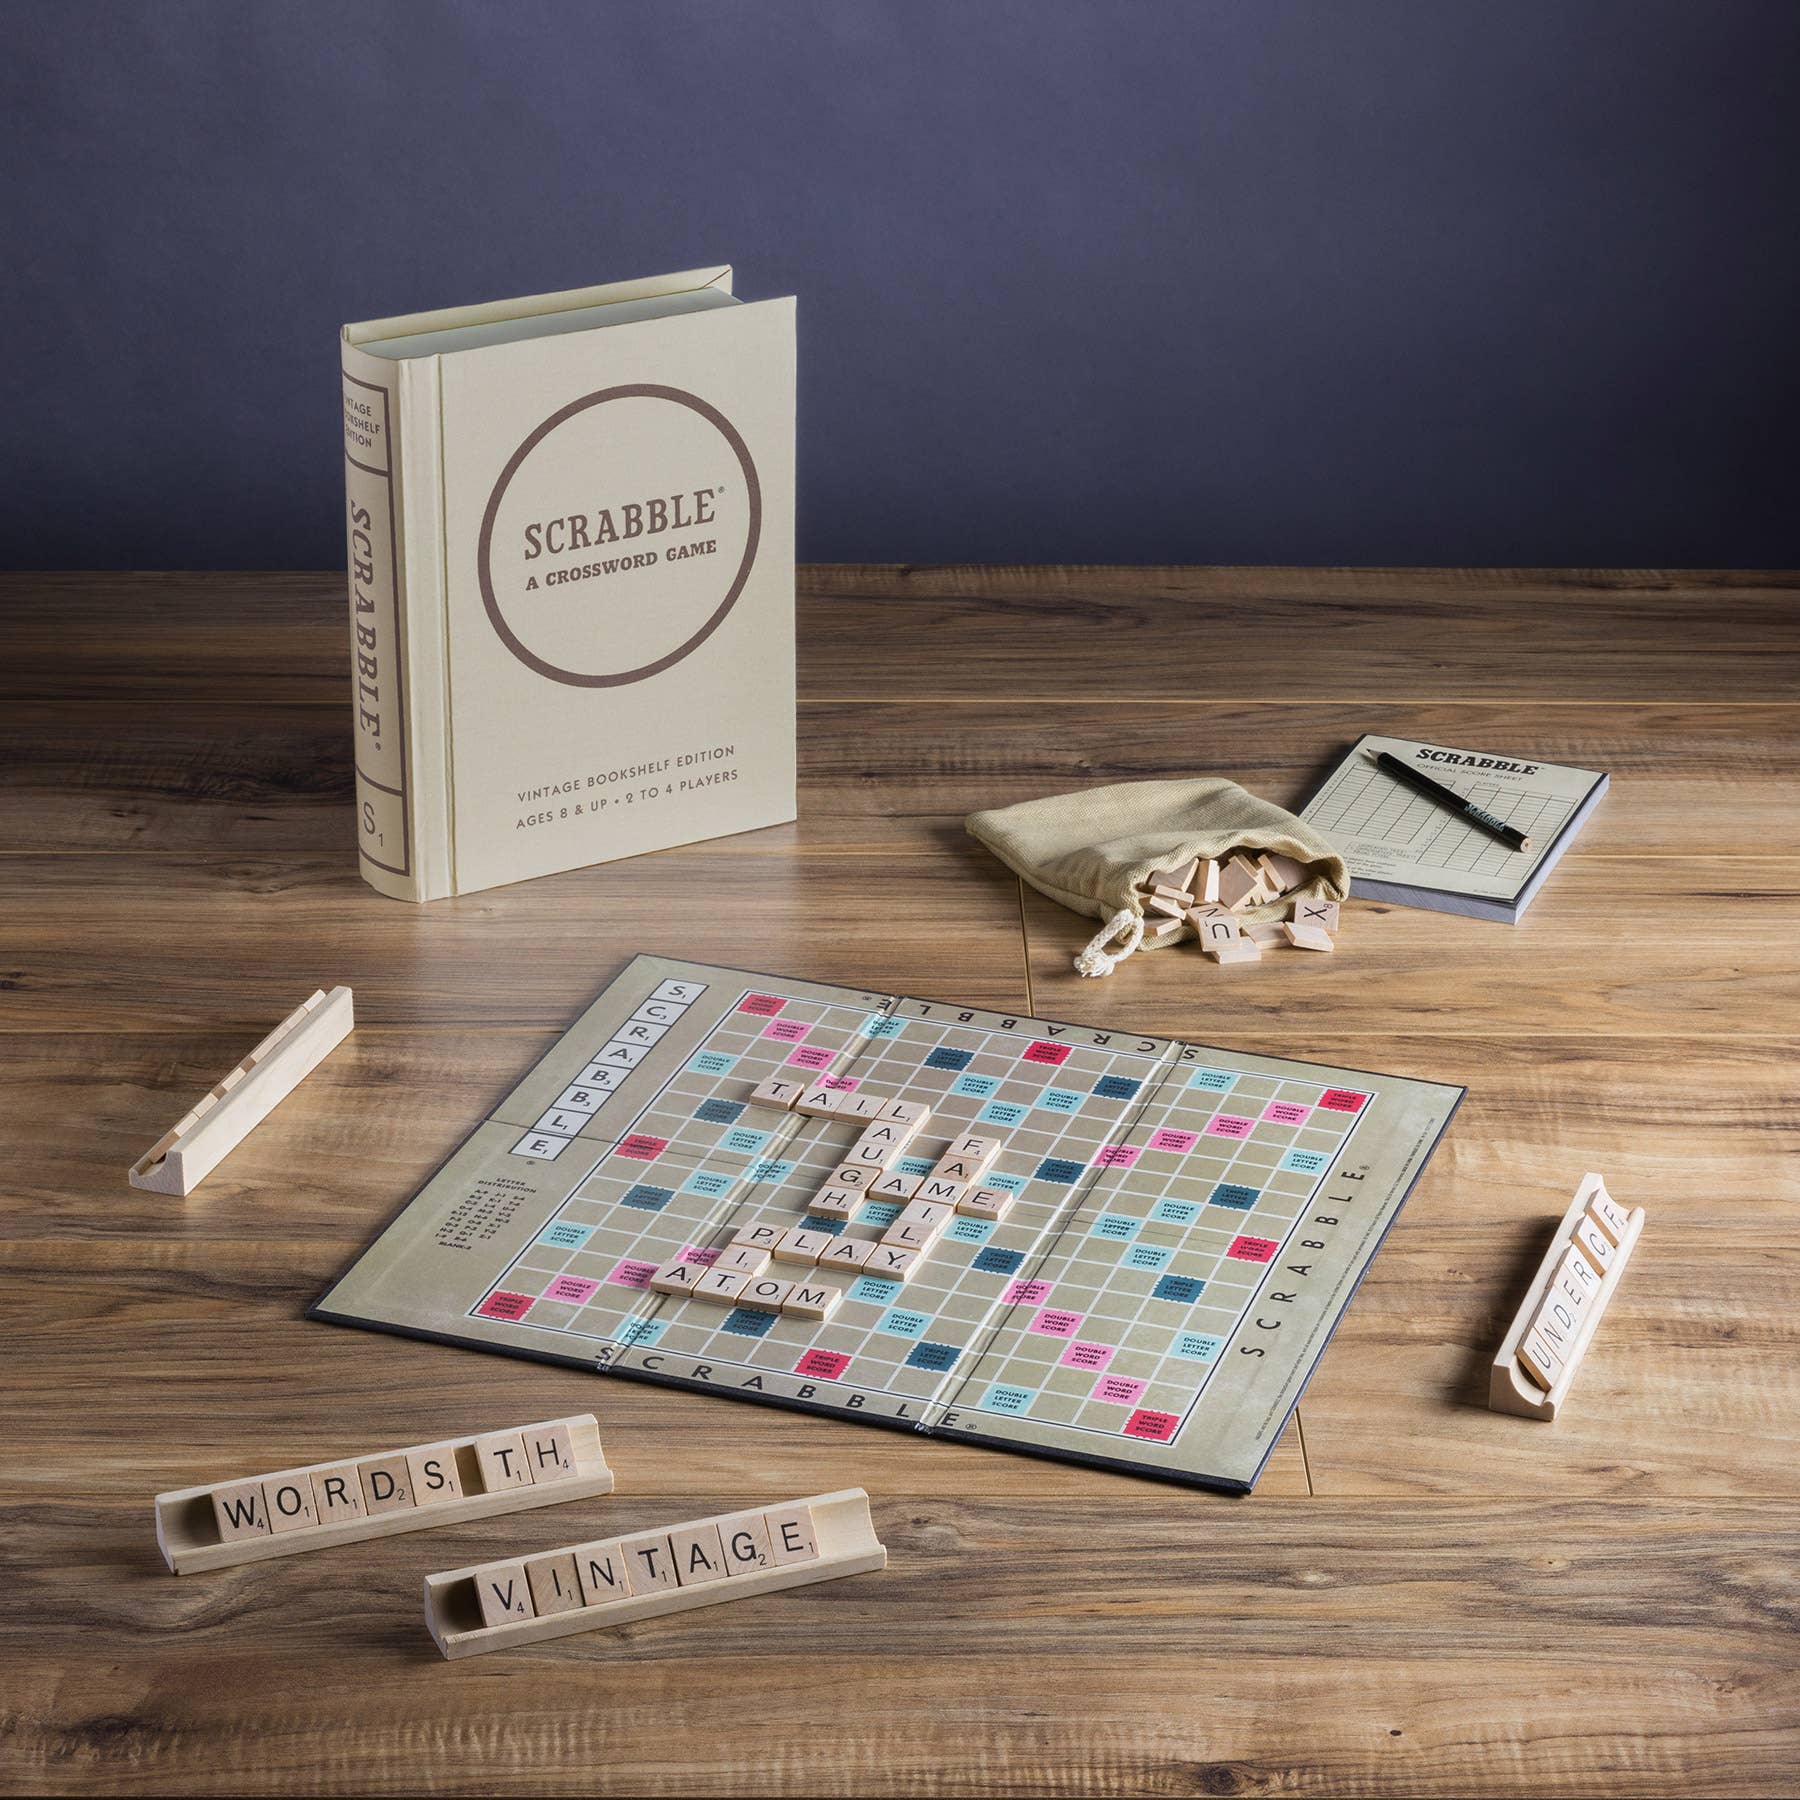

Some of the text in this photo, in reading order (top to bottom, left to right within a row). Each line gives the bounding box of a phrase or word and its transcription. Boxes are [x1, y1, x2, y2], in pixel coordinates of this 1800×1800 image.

[525, 539, 717, 591] A CROSSWORD GAME
[1416, 748, 1540, 776] SCRABBLE
[517, 745, 735, 802] VINTAGE BOOKSHELF EDITION
[516, 769, 738, 829] AGES 8 & UP 2 TO 4 PLAYERS
[775, 1022, 805, 1030] DOUBLE
[1200, 1076, 1226, 1084] LETTER
[1201, 1072, 1231, 1080] DOUBLE
[964, 1077, 994, 1085] DOUBLE
[960, 1086, 986, 1094] SCORE
[1048, 1092, 1079, 1100] DOUBLE
[991, 1105, 1022, 1113] DOUBLE
[1045, 1101, 1070, 1109] SCORE
[1274, 1104, 1305, 1113] DOUBLE
[990, 1109, 1017, 1117] LETTER
[1271, 1113, 1297, 1121] SCORE
[1274, 1109, 1300, 1117] WORD
[987, 1114, 1013, 1122] SCORE
[1218, 1117, 1249, 1126] DOUBLE
[1217, 1122, 1243, 1130] WORD
[732, 1131, 763, 1140] DOUBLE
[1214, 1127, 1241, 1135] SCORE
[731, 1136, 758, 1144] LETTER
[1161, 1132, 1192, 1140] DOUBLE
[727, 1141, 754, 1149] SCORE
[1157, 1141, 1184, 1149] SCORE
[1292, 1152, 1324, 1161] DOUBLE
[1289, 1162, 1316, 1170] SCORE
[1292, 1157, 1319, 1166] LETTER
[695, 1180, 722, 1188] LETTER
[697, 1175, 728, 1184] DOUBLE
[988, 1176, 1020, 1185] DOUBLE
[691, 1184, 718, 1193] SCORE
[987, 1181, 1015, 1189] LETTER
[1163, 1202, 1195, 1211] DOUBLE
[1160, 1212, 1187, 1220] SCORE
[1162, 1207, 1190, 1216] LETTER
[957, 1220, 989, 1229] DOUBLE
[1104, 1217, 1136, 1227] DOUBLE
[554, 1225, 586, 1234] DOUBLE
[956, 1225, 983, 1234] LETTER
[1100, 1227, 1127, 1236] SCORE
[552, 1230, 580, 1239] LETTER
[953, 1230, 980, 1239] SCORE
[548, 1235, 576, 1244] SCORE
[1242, 1239, 1269, 1248] TRIPLE
[1134, 1248, 1167, 1257] DOUBLE
[1236, 1249, 1264, 1258] SCORE
[1133, 1253, 1162, 1262] LETTER
[1131, 1258, 1158, 1267] SCORE
[559, 1279, 592, 1289] DOUBLE
[862, 1280, 895, 1290] DOUBLE
[558, 1285, 585, 1293] WORD
[861, 1286, 889, 1295] LETTER
[553, 1290, 581, 1299] SCORE
[858, 1291, 886, 1300] SCORE
[497, 1296, 524, 1304] TRIPLE
[492, 1301, 520, 1310] WORD
[488, 1306, 516, 1315] SCORE
[891, 1313, 924, 1323] DOUBLE
[1042, 1318, 1070, 1327] WORD
[1043, 1313, 1076, 1323] DOUBLE
[890, 1319, 918, 1328] LETTER
[886, 1324, 915, 1333] SCORE
[1039, 1324, 1067, 1333] SCORE
[1183, 1336, 1216, 1346] DOUBLE
[1074, 1345, 1107, 1355] DOUBLE
[1182, 1342, 1211, 1351] LETTER
[1073, 1351, 1101, 1360] WORD
[1179, 1347, 1207, 1357] SCORE
[813, 1354, 841, 1363] TRIPLE
[1070, 1356, 1098, 1366] SCORE
[809, 1359, 837, 1368] WORD
[805, 1364, 833, 1374] SCORE
[1105, 1379, 1140, 1389] DOUBLE
[994, 1389, 1028, 1399] DOUBLE
[1105, 1385, 1133, 1394] WORD
[993, 1394, 1023, 1404] LETTER
[1102, 1390, 1130, 1400] SCORE
[990, 1400, 1019, 1410] SCORE
[1140, 1414, 1169, 1423] TRIPLE
[1137, 1419, 1166, 1429] WORD
[1134, 1425, 1163, 1435] SCORE
